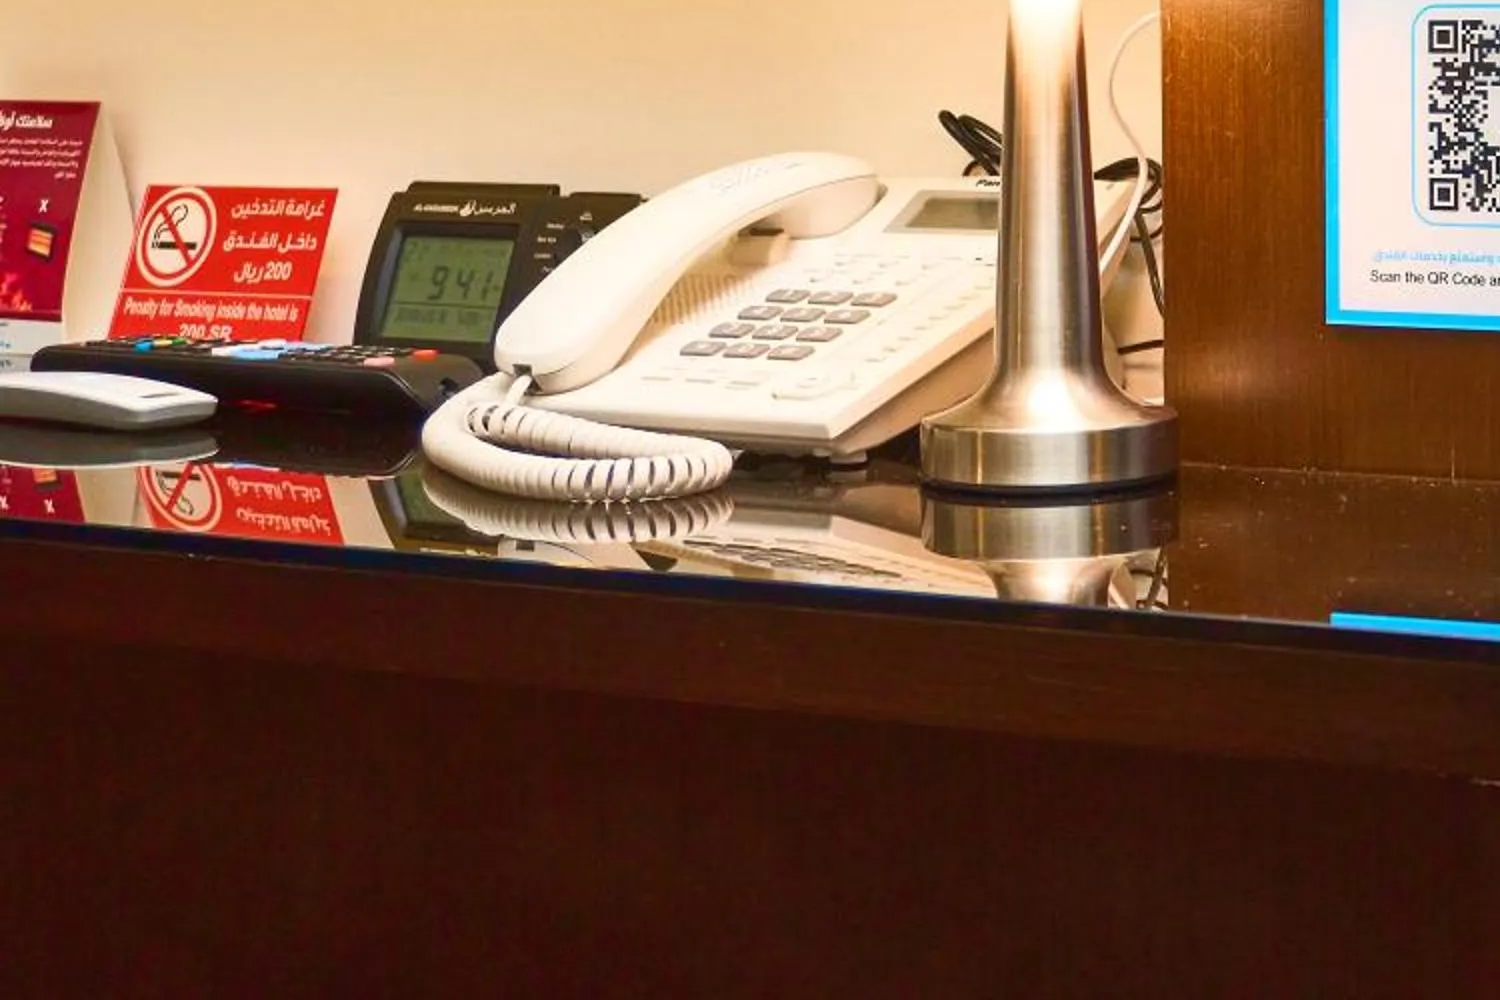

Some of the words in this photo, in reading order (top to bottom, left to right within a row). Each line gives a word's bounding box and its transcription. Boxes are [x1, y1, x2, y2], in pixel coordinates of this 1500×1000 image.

[230, 197, 287, 220] التدخين
[285, 198, 325, 221] غرامة
[222, 229, 279, 252] الفندق
[277, 231, 318, 253] داخل
[233, 260, 264, 285] ريال
[263, 260, 294, 281] 200
[1369, 269, 1401, 283] Scan
[1404, 271, 1425, 285] the
[1427, 271, 1449, 285] QR
[1452, 271, 1487, 286] Code
[174, 298, 216, 322] Smoking
